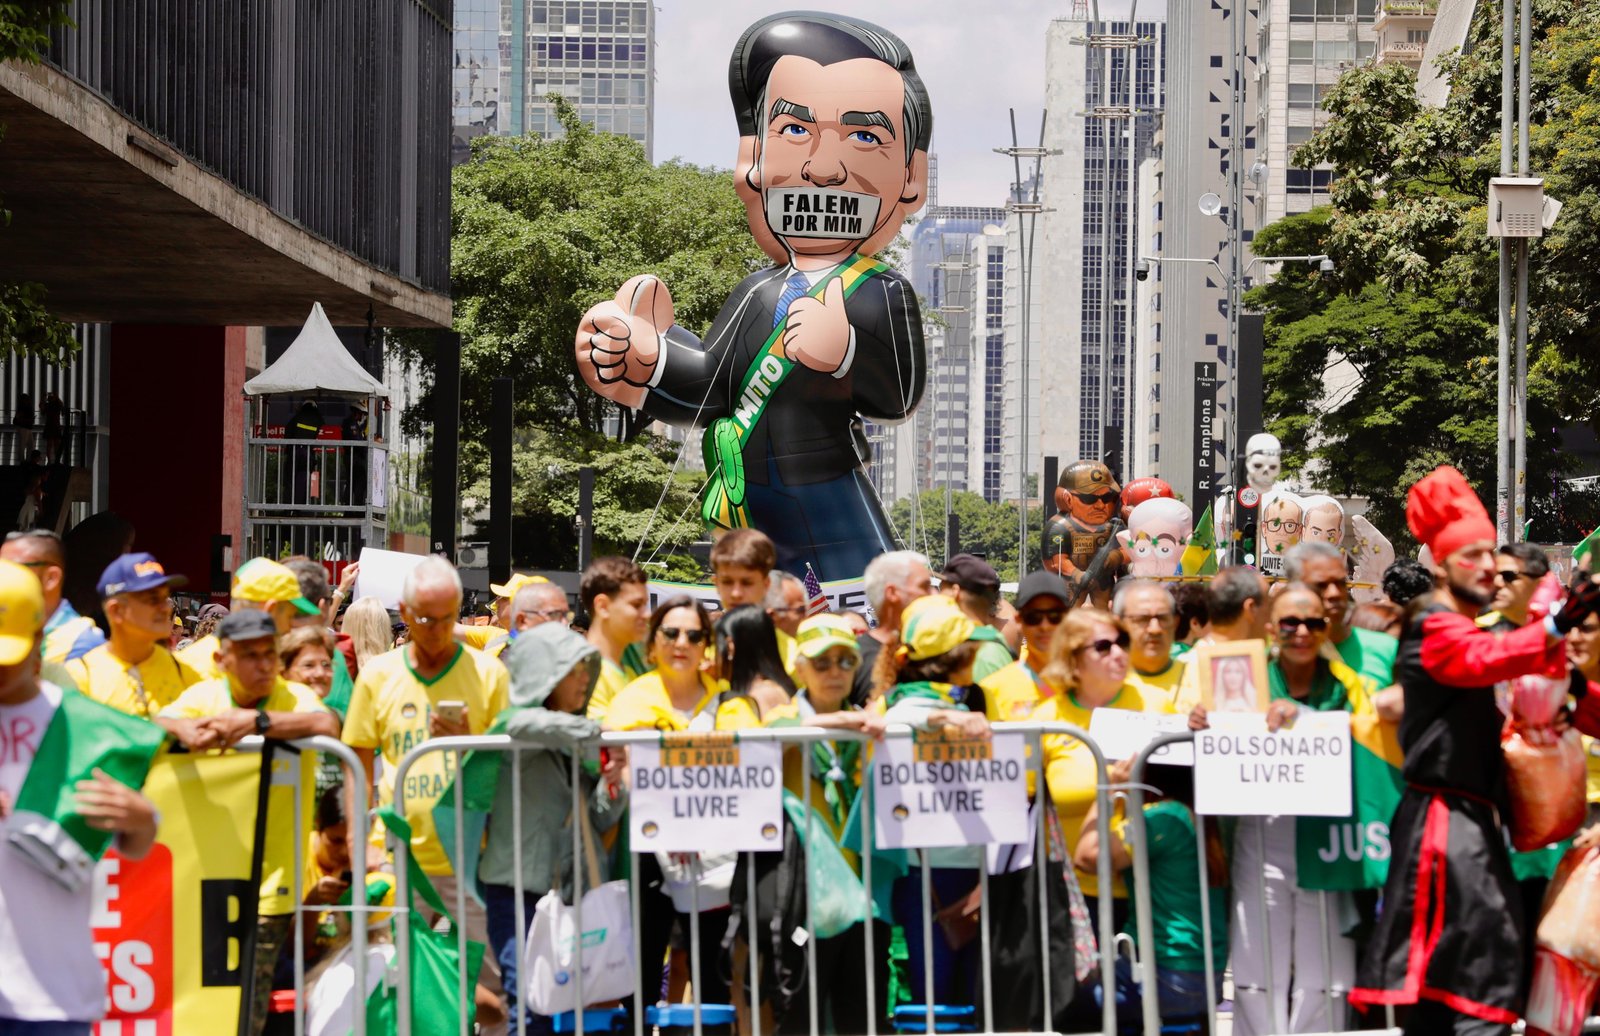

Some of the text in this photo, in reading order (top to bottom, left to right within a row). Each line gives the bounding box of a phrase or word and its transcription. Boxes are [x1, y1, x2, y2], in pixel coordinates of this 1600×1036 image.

[783, 193, 859, 215] FALEM
[782, 214, 862, 234] POR MIM
[736, 354, 784, 430] MITO
[1199, 399, 1212, 490] R. Pamplona
[1262, 556, 1285, 570] JUNTE-
[1202, 734, 1342, 757] BOLSONARO
[636, 766, 775, 790] BOLSONARO
[880, 758, 1020, 786] BOLSONARO
[1239, 763, 1305, 783] LIVRE
[405, 773, 446, 800] BRA
[673, 796, 739, 819] LIVRE
[918, 790, 984, 814] LIVRE
[1318, 821, 1392, 863] JUS
